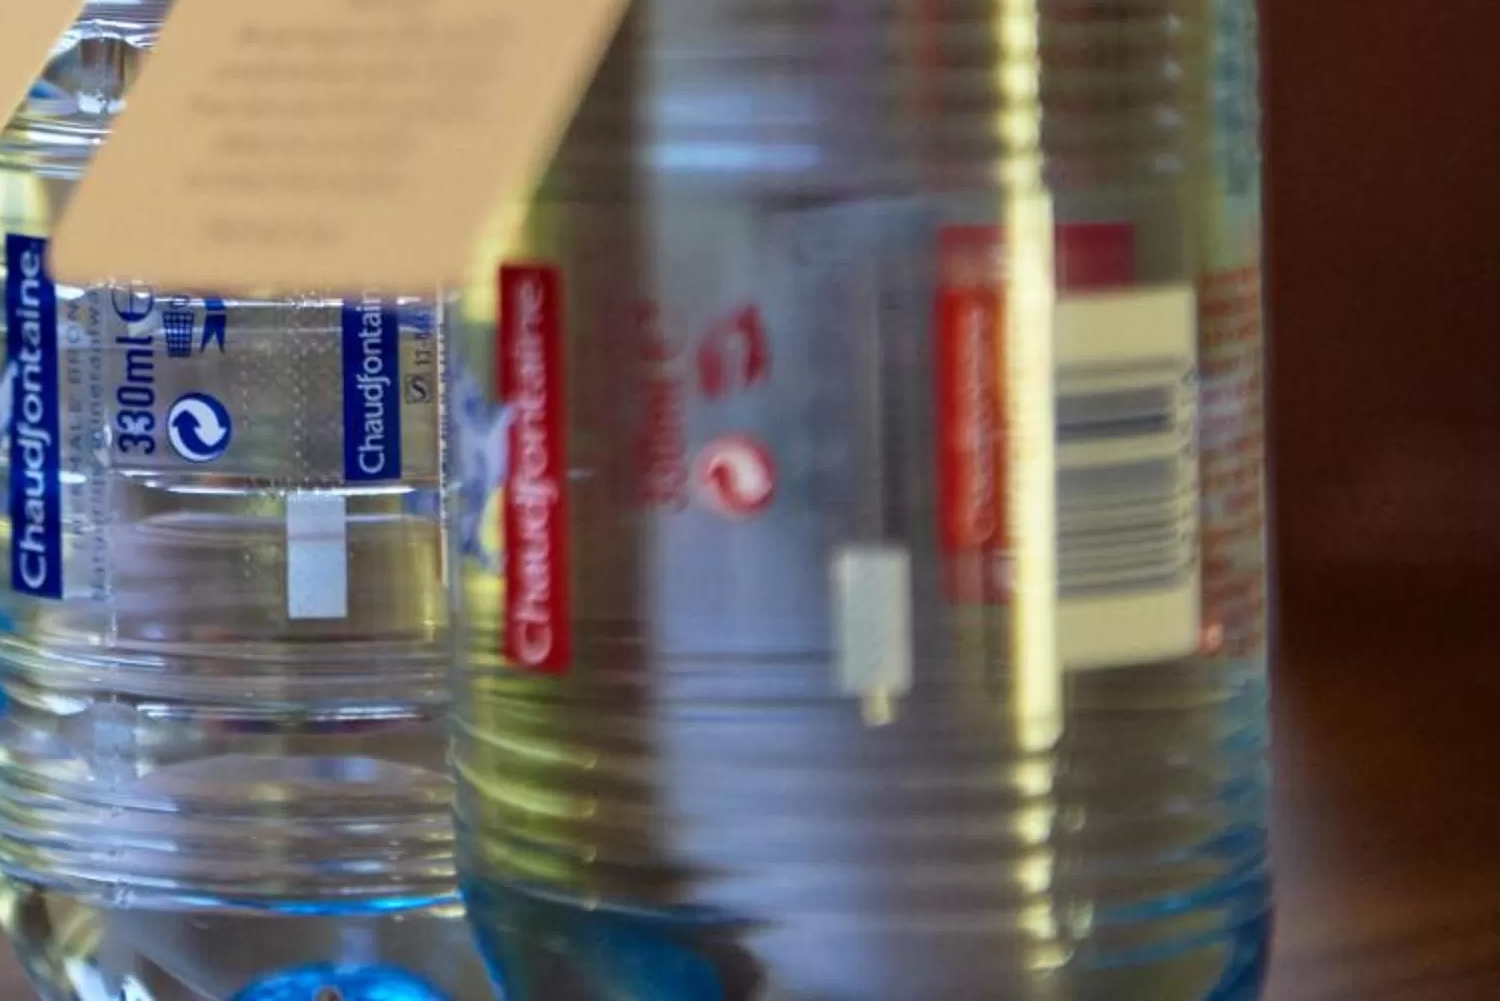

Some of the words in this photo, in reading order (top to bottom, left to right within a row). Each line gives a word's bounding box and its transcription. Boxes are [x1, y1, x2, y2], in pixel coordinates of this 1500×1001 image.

[15, 250, 53, 590] Chaudfontaine
[115, 336, 156, 455] 330ml
[513, 275, 559, 667] Chaudfontaine
